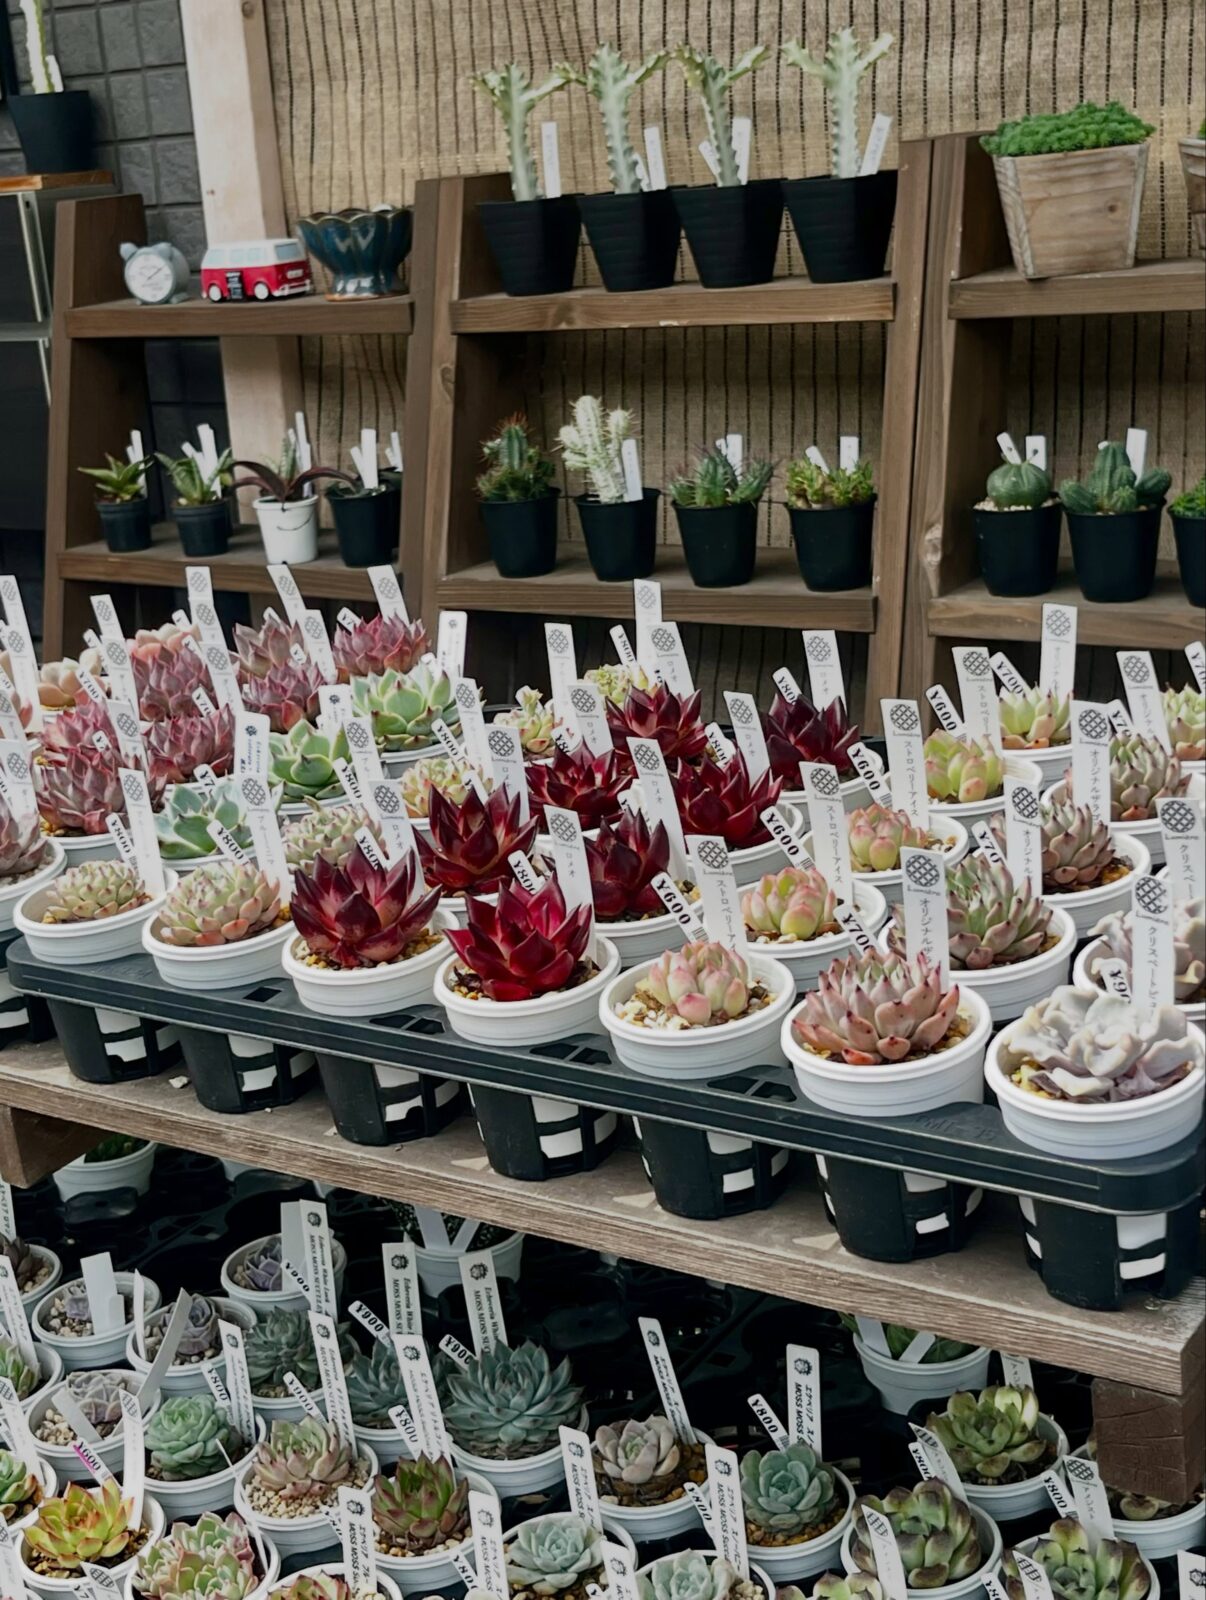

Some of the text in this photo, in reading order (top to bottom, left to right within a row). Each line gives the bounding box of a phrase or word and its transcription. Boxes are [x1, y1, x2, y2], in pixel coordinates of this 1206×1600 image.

[927, 689, 958, 733] ¥600
[852, 747, 881, 791] ¥600
[765, 812, 800, 857] ¥600
[656, 878, 692, 925] ¥600
[751, 1399, 778, 1433] ¥800
